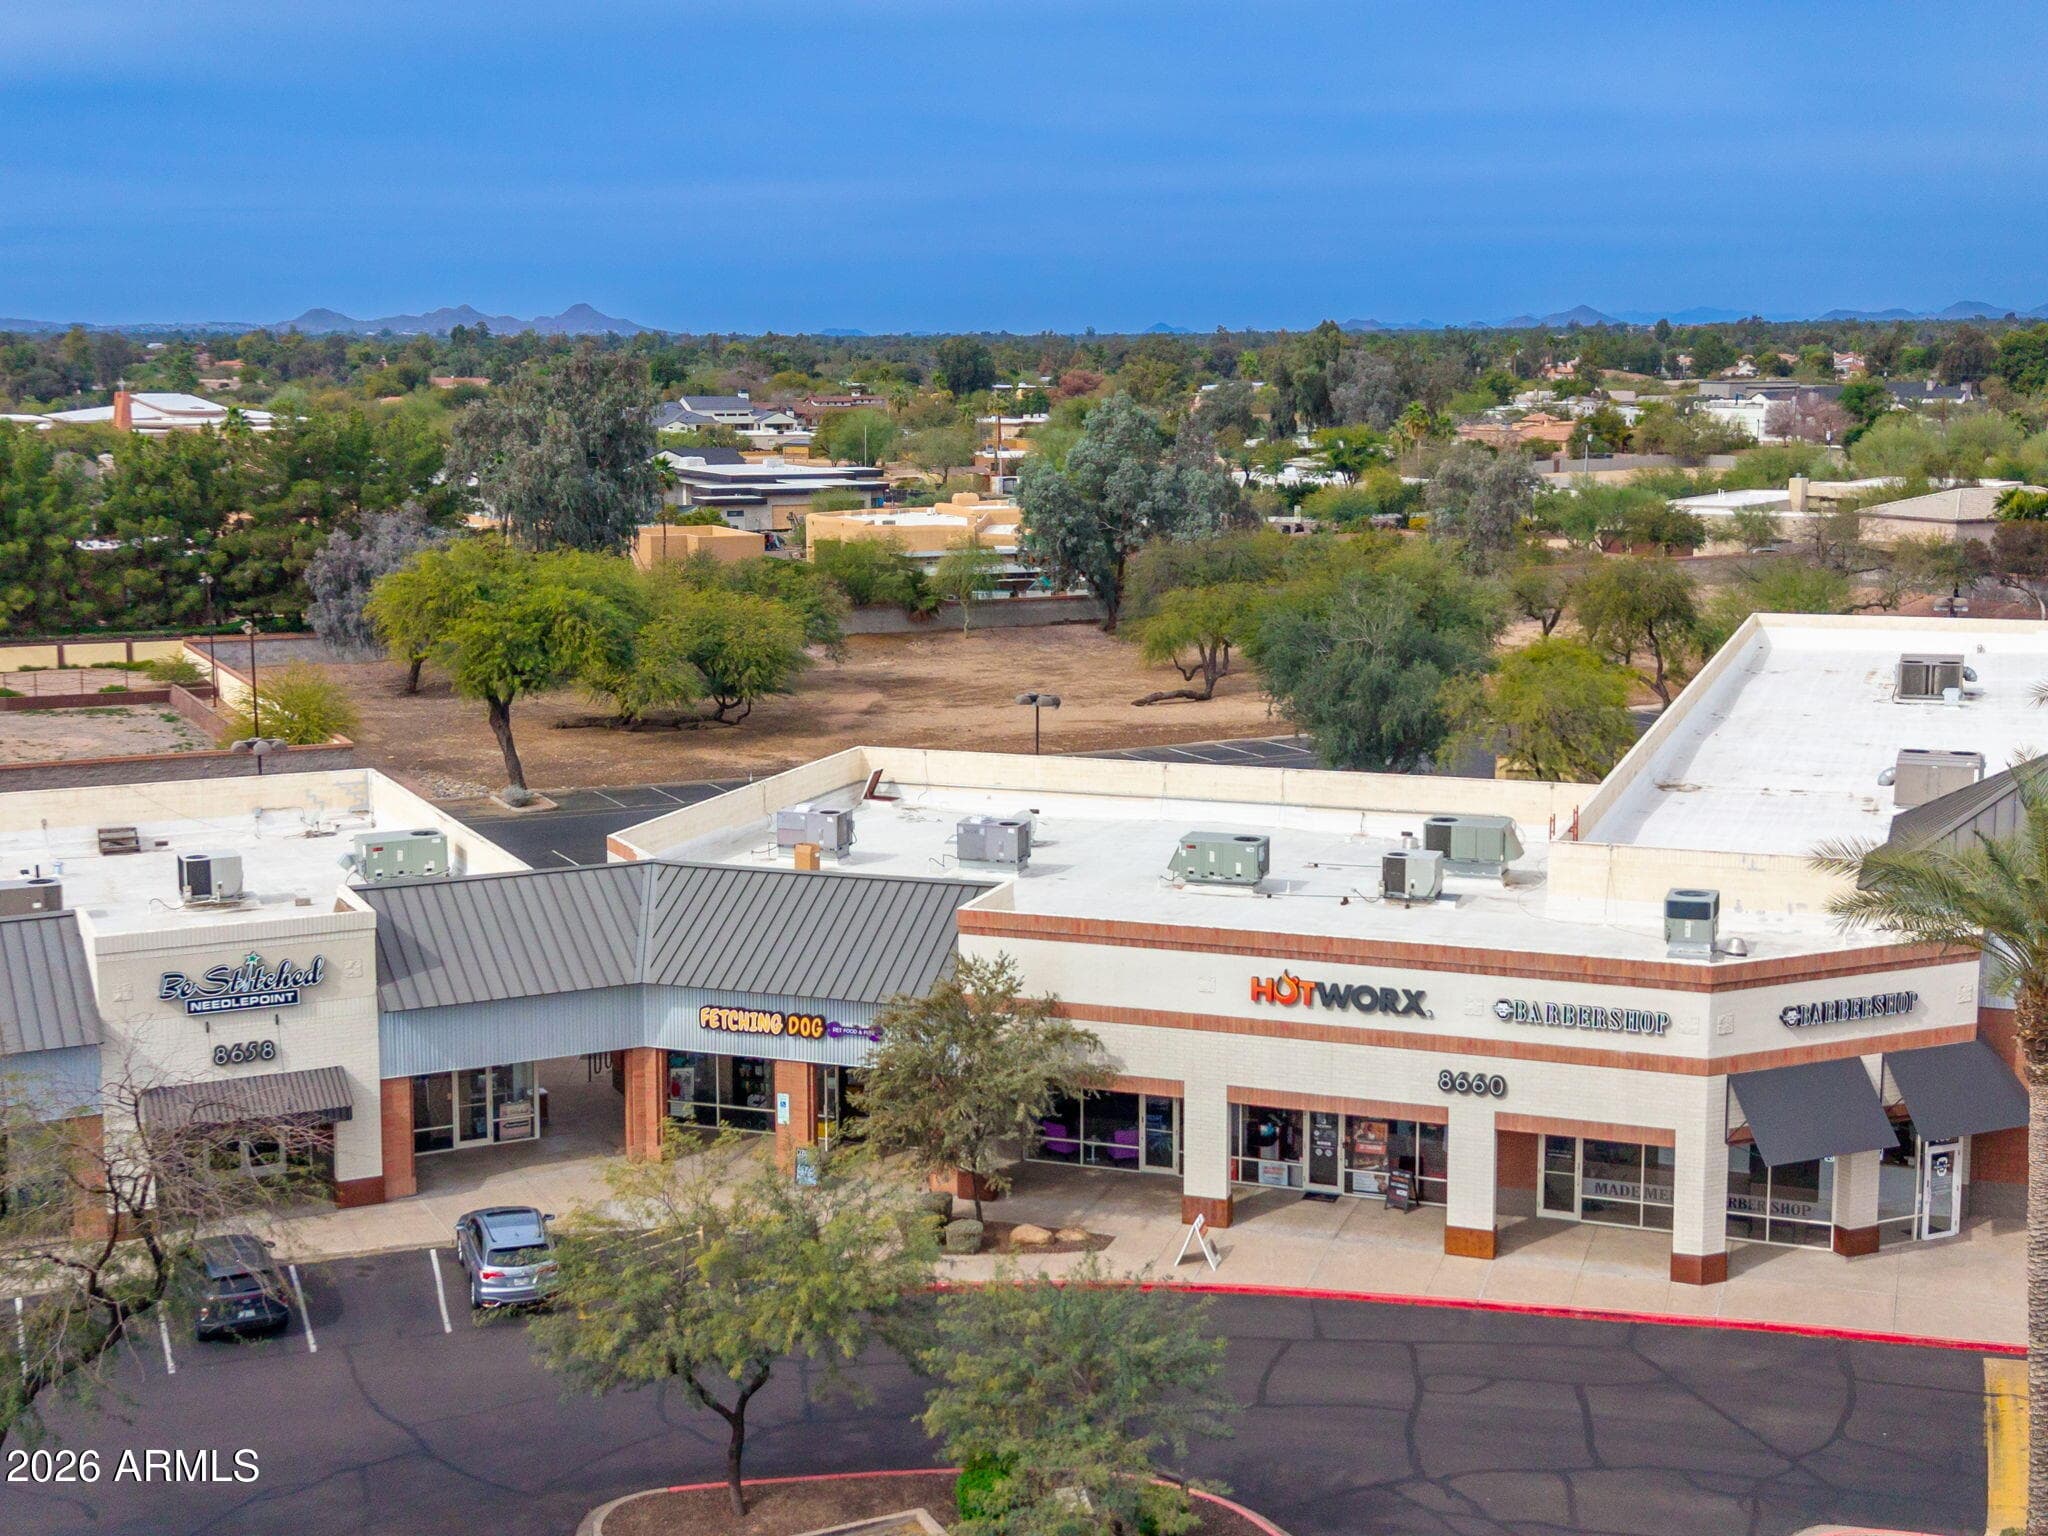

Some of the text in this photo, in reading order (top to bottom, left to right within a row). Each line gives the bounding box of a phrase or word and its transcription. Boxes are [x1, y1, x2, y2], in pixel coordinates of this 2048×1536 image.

[159, 953, 326, 1001] Be Stitched
[189, 992, 295, 1012] NEEDLEPOINT
[1250, 969, 1428, 1018] HOTWORX
[700, 1005, 826, 1039] FETCHING DOG
[1513, 999, 1671, 1035] BARBERSHOP
[1800, 991, 1918, 1027] BARBERSHOP
[843, 1027, 857, 1035] FOOD
[213, 1040, 276, 1066] 8658
[1438, 1069, 1507, 1098] 8660
[1594, 1182, 1674, 1202] MADE ME
[1728, 1196, 1812, 1217] RBER SHOP
